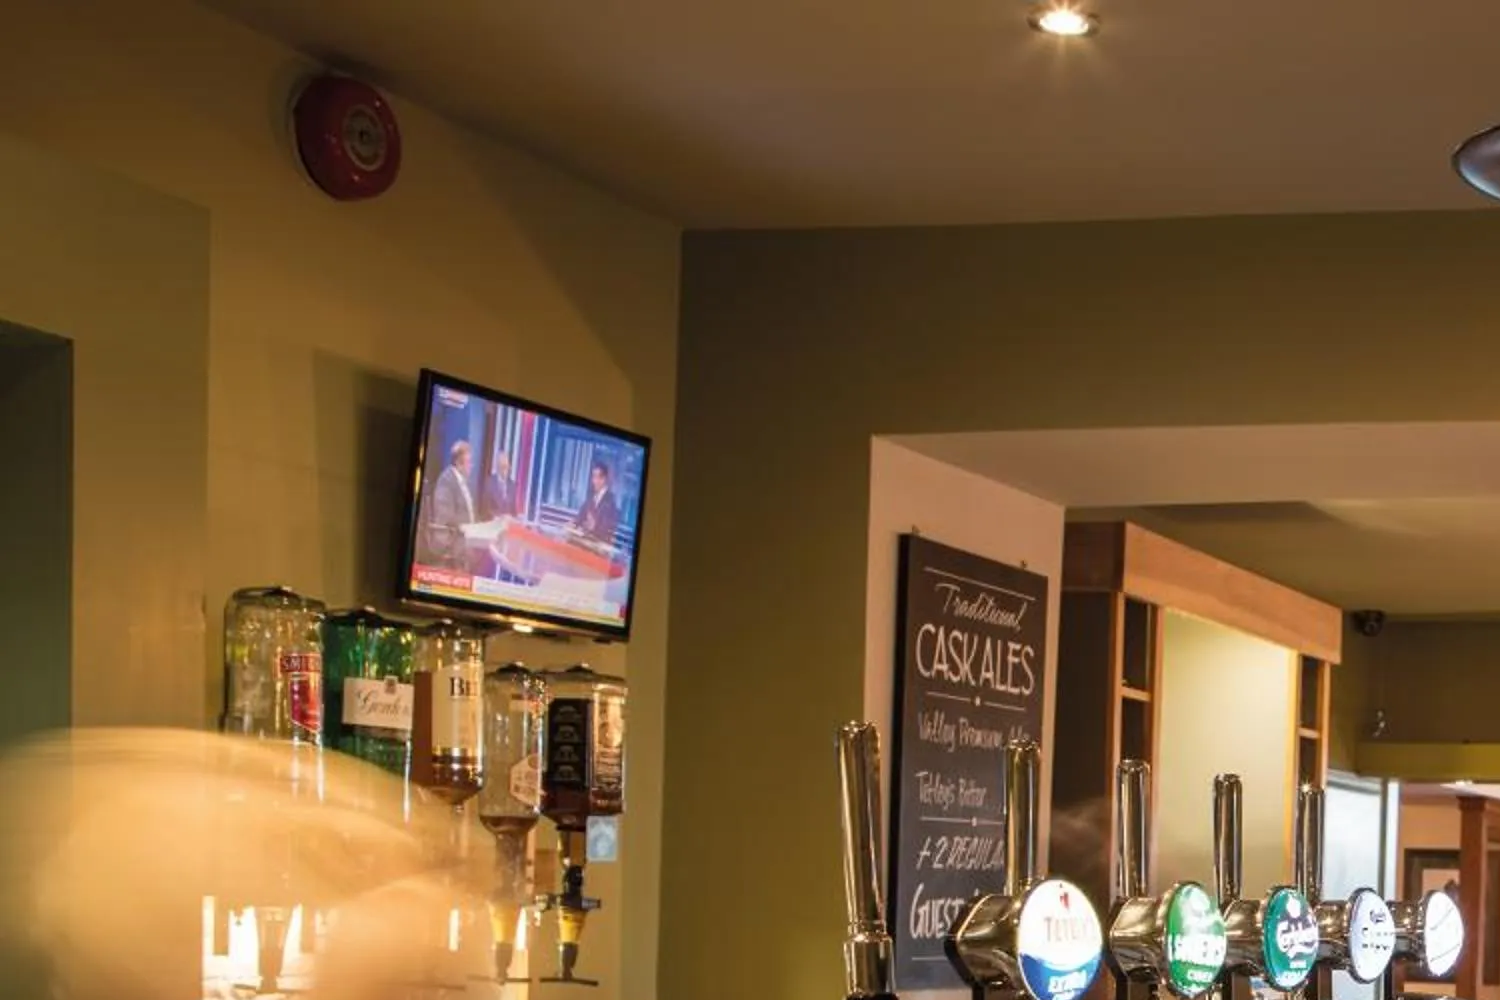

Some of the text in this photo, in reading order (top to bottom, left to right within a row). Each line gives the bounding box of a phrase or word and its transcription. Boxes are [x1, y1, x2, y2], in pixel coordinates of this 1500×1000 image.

[935, 583, 1028, 632] Traditional
[915, 623, 1035, 696] CASK ALES
[946, 836, 1005, 871] REGULA
[1043, 916, 1098, 942] TETL
